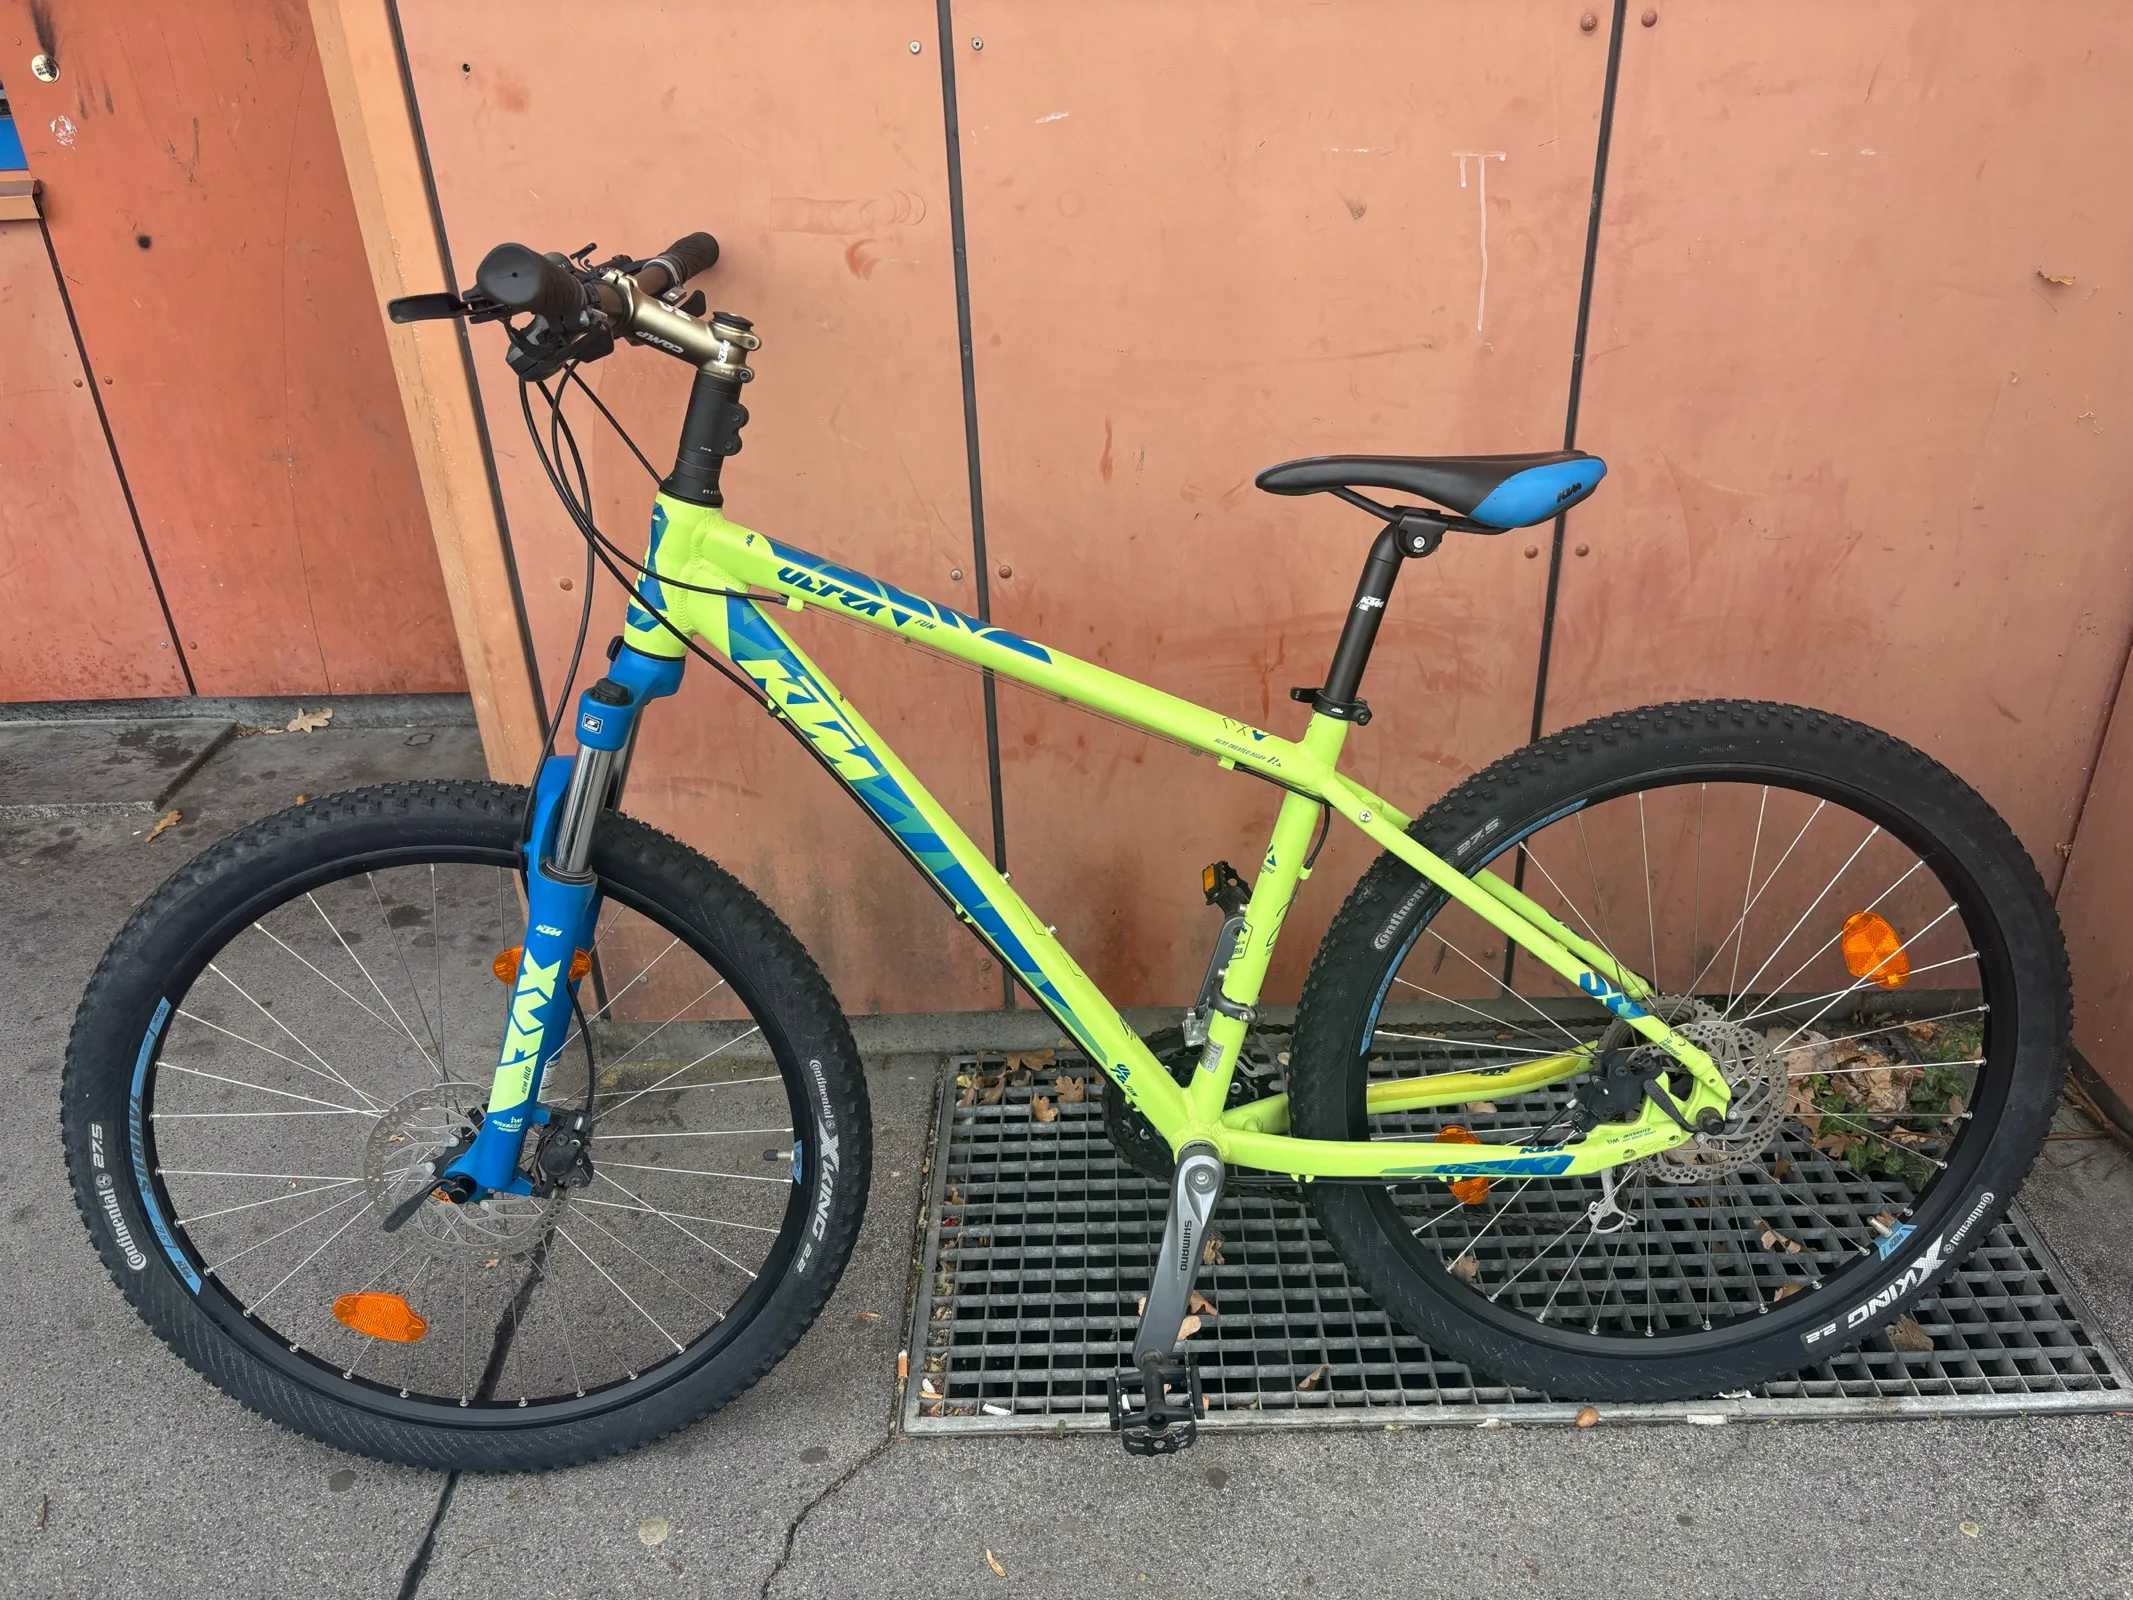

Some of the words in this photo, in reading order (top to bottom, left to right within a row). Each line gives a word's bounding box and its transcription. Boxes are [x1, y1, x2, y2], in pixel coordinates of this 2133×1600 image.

[635, 331, 684, 354] COMP
[745, 534, 755, 547] KTM
[776, 566, 887, 617] ULTRA
[914, 619, 937, 630] FUN
[1360, 595, 1385, 608] KTM
[736, 659, 880, 780] KTM
[1214, 738, 1229, 748] HEAT
[1228, 743, 1251, 757] TREATED
[1249, 751, 1267, 760] ALLOY
[1456, 817, 1499, 856] 27.5
[535, 924, 563, 937] KTM
[1374, 880, 1432, 950] Continent
[809, 1060, 835, 1119] Continental
[91, 1123, 105, 1169] 27.5
[1518, 1145, 1565, 1154] KTM
[99, 1187, 147, 1271] Continental
[1949, 1191, 1995, 1247] Continental
[797, 1243, 813, 1273] 2.2
[1179, 1220, 1193, 1272] SHIMANO
[174, 1259, 194, 1280] KTM
[1806, 1322, 1837, 1344] 2.2
